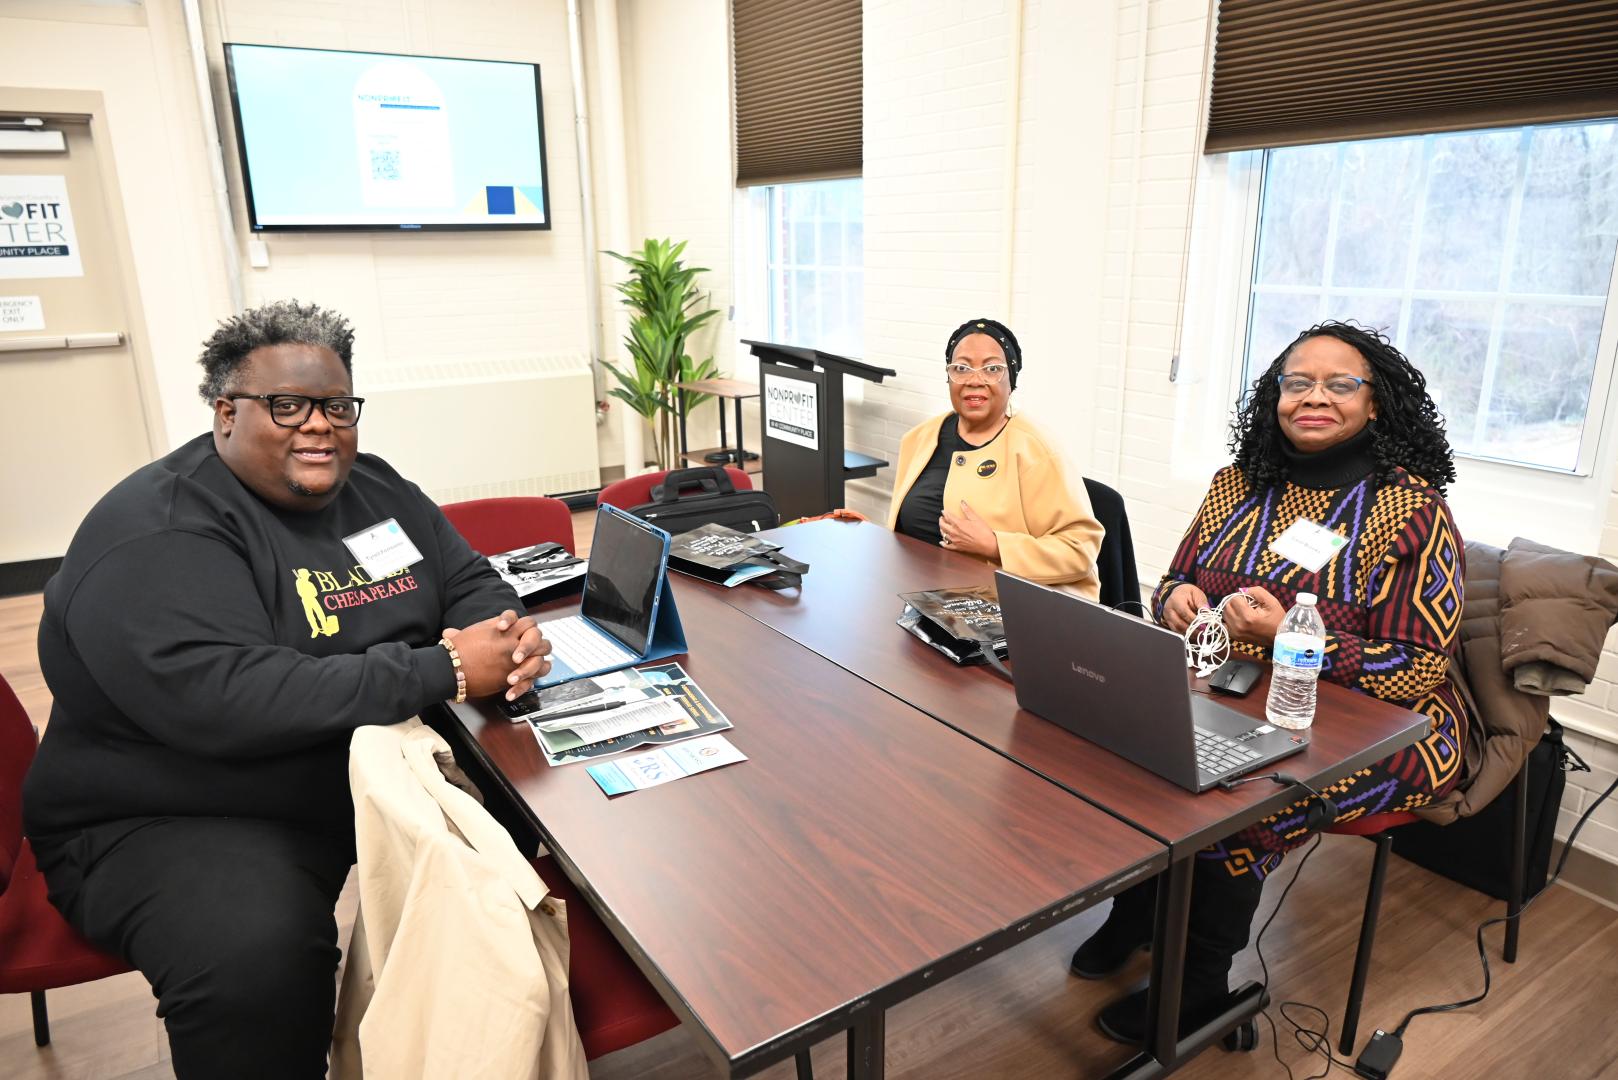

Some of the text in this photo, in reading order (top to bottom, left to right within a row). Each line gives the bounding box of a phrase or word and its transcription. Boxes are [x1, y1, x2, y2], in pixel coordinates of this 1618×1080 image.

[27, 246, 61, 256] PLACE
[323, 575, 418, 611] CHESAPEAKE
[1071, 661, 1106, 683] Lenovo
